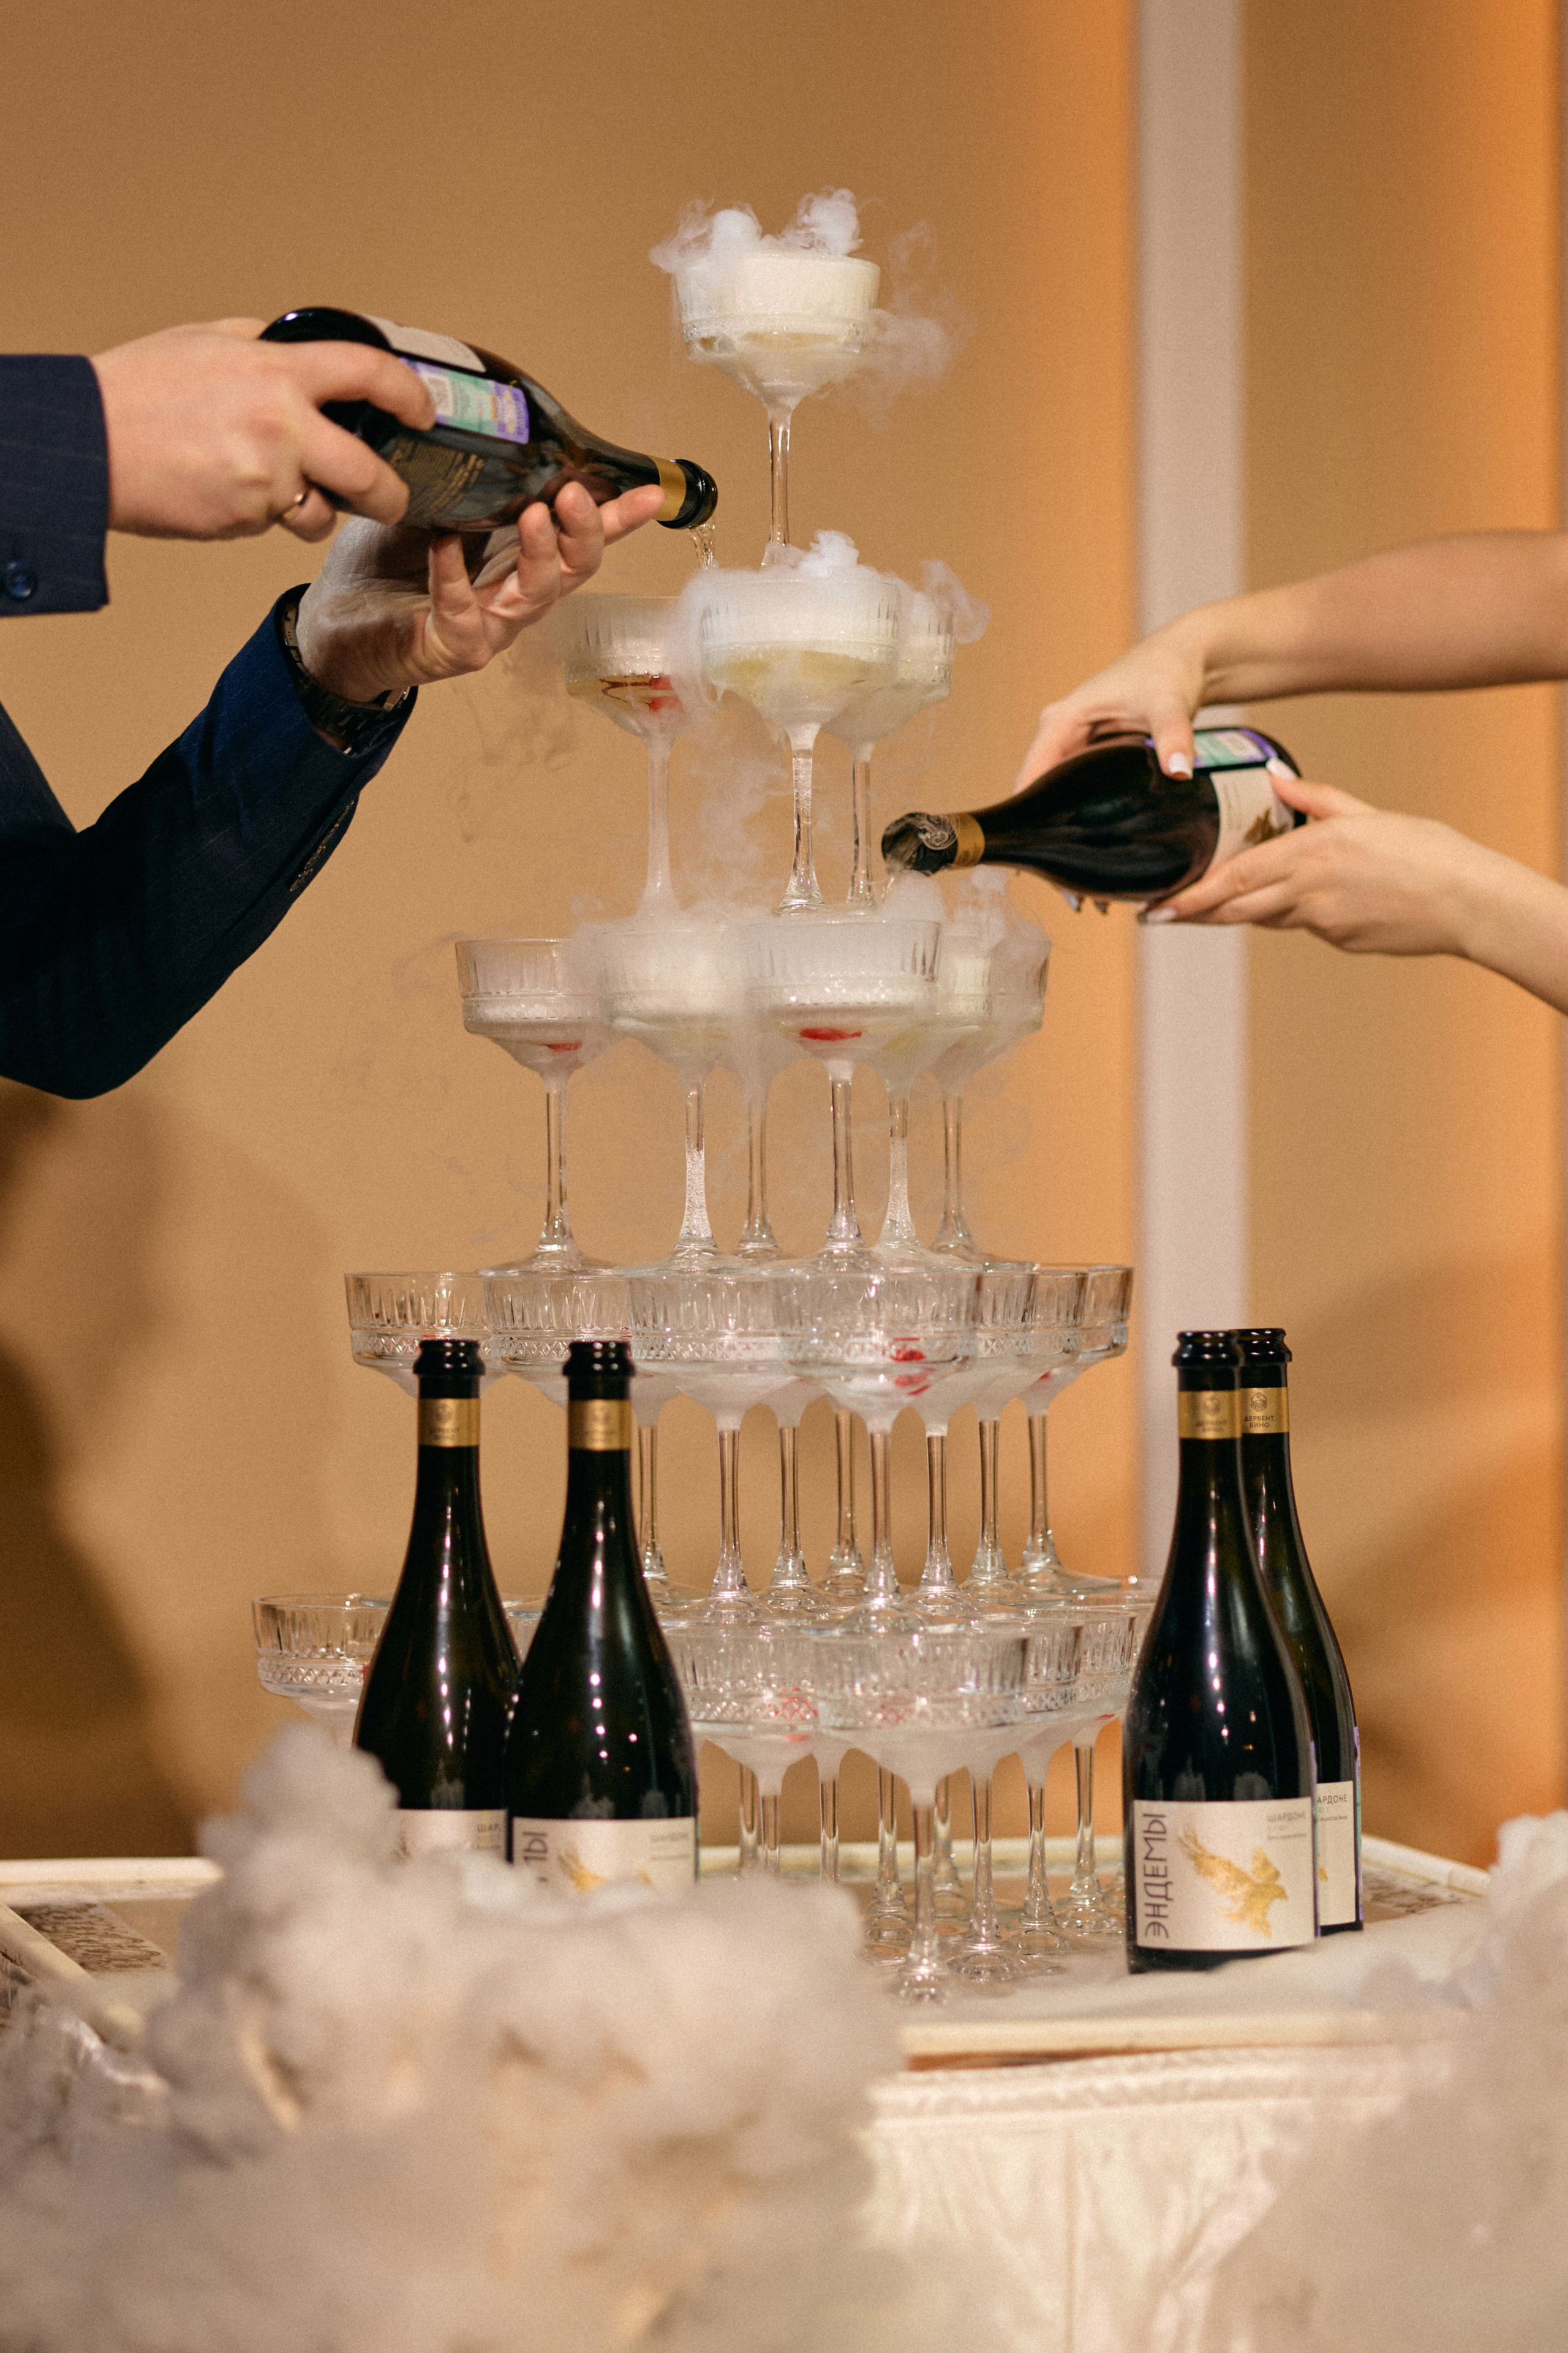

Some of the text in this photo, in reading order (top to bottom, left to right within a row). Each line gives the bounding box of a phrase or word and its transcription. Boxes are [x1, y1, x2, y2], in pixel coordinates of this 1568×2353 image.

[1317, 1794, 1347, 1805] АРДОНЕ
[477, 1823, 501, 1832] ШАР
[1142, 1813, 1174, 1939] ЭНДЕМЫ
